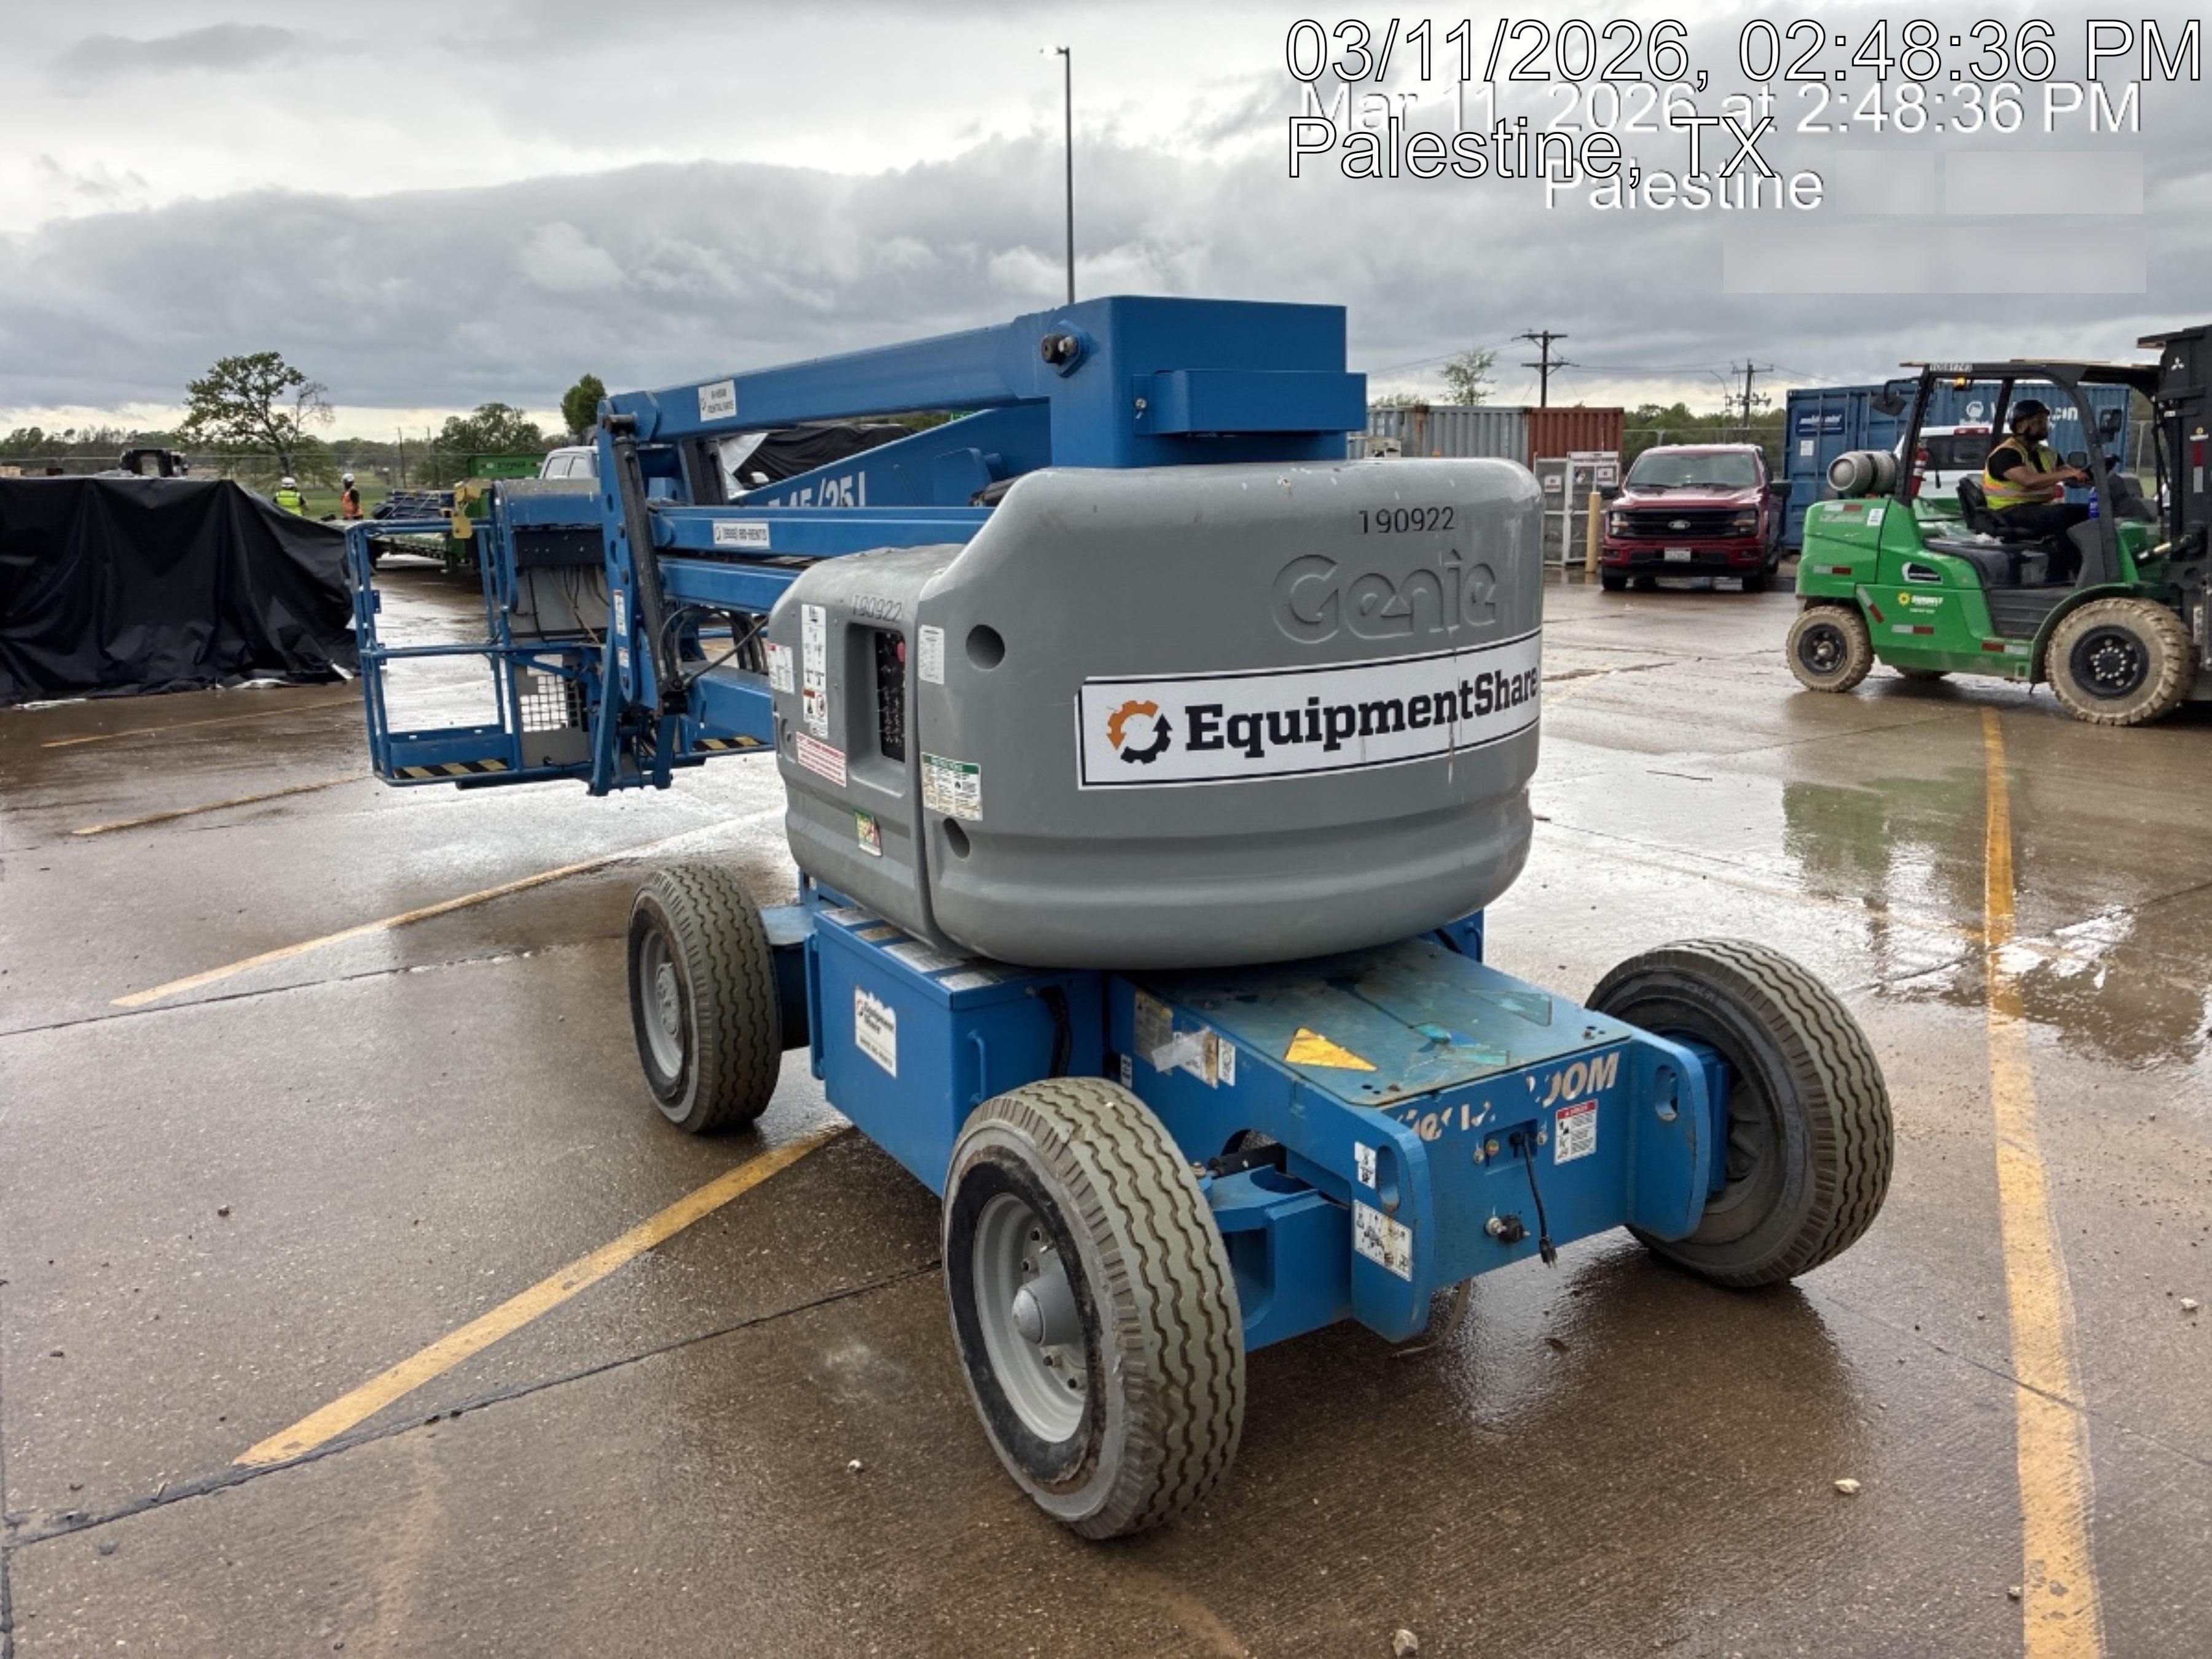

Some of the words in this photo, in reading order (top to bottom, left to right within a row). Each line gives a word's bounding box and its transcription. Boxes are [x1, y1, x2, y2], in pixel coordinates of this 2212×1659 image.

[1359, 506, 1455, 534] 190922
[1273, 548, 1496, 645] Genie
[1185, 667, 1537, 758] EquipmentShare
